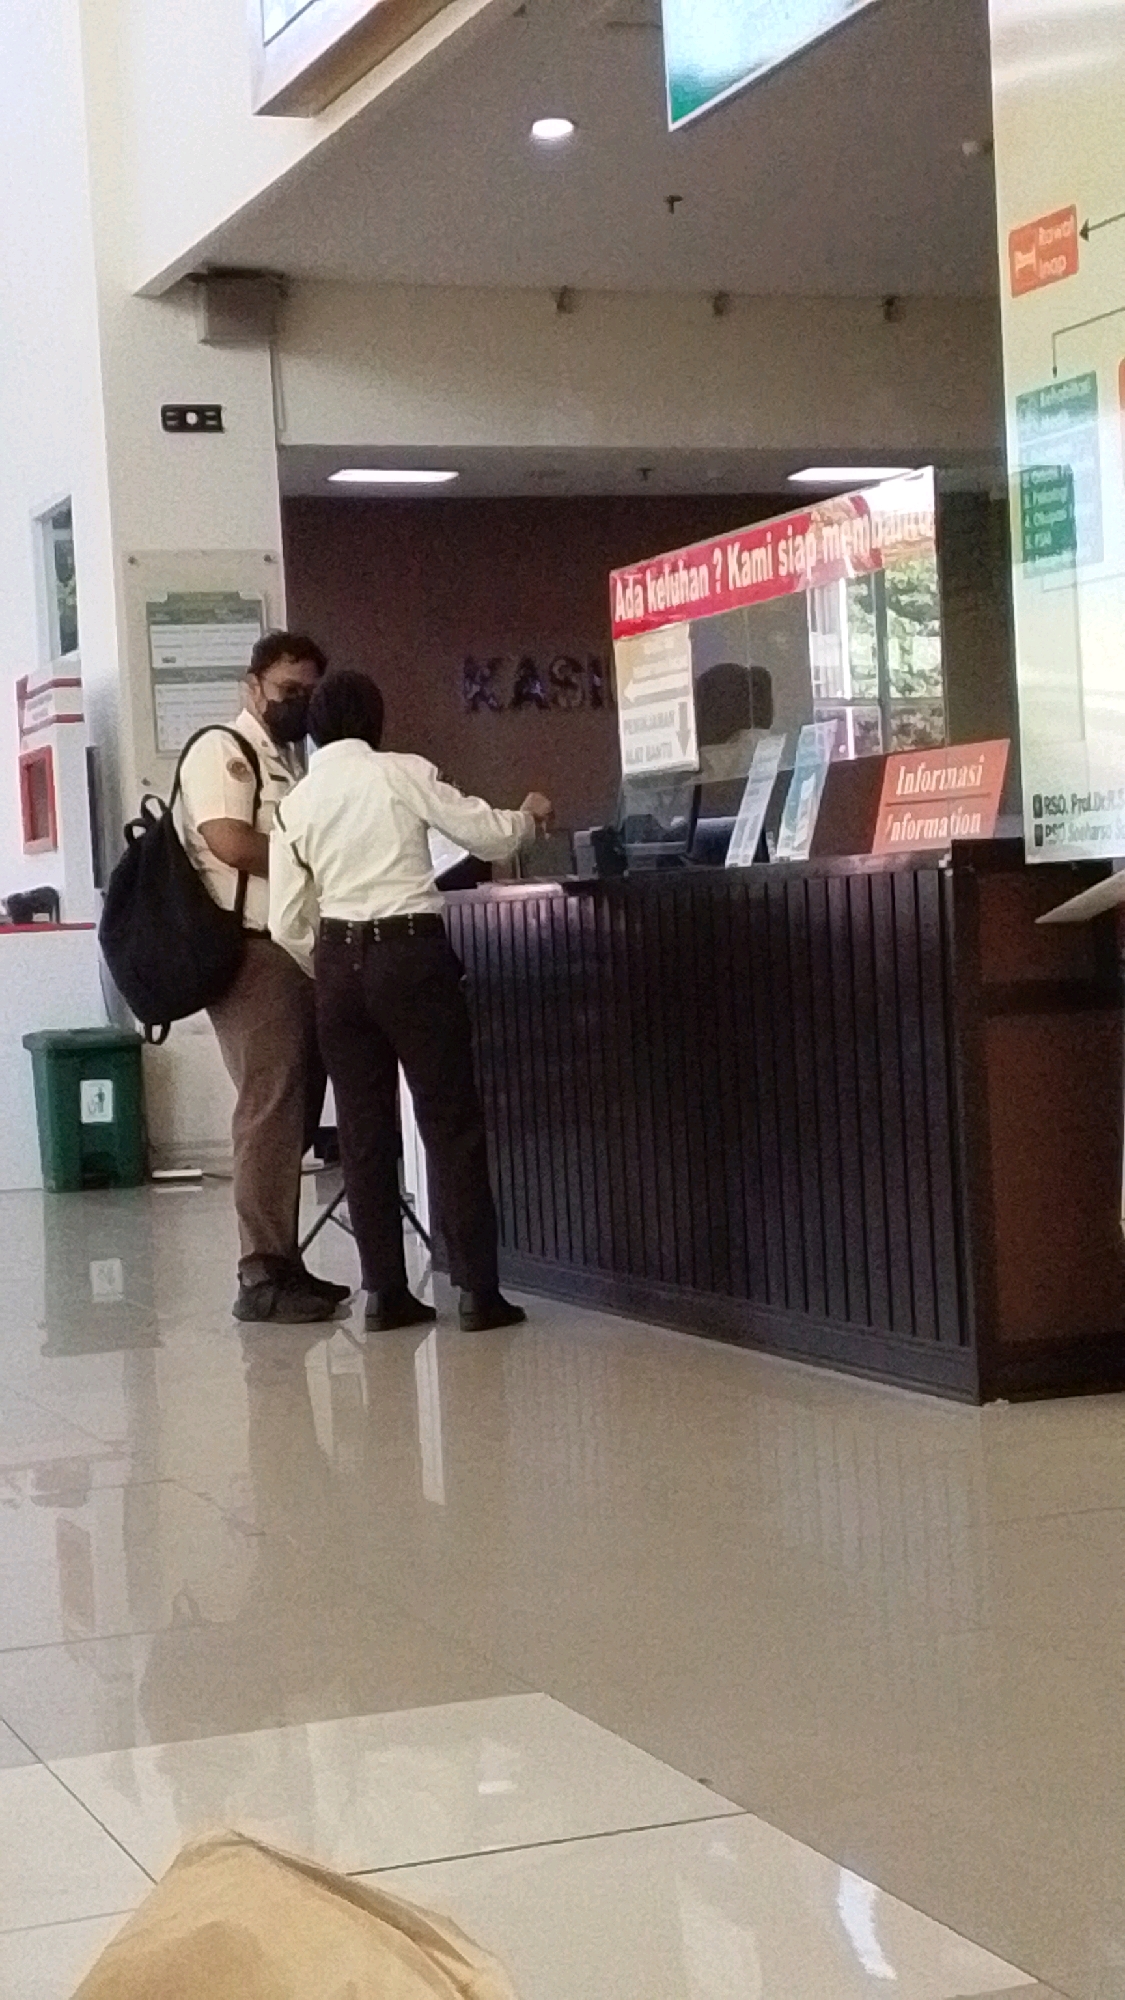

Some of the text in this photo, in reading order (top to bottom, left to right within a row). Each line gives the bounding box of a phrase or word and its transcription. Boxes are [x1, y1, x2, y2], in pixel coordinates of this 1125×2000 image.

[614, 576, 645, 624] Ada
[645, 558, 711, 614] keluhan
[712, 547, 722, 595] ?
[726, 531, 774, 591] Kami
[777, 523, 817, 580] siap
[463, 654, 605, 713] KASI
[895, 754, 986, 796] Informasi
[884, 805, 982, 842] Information
